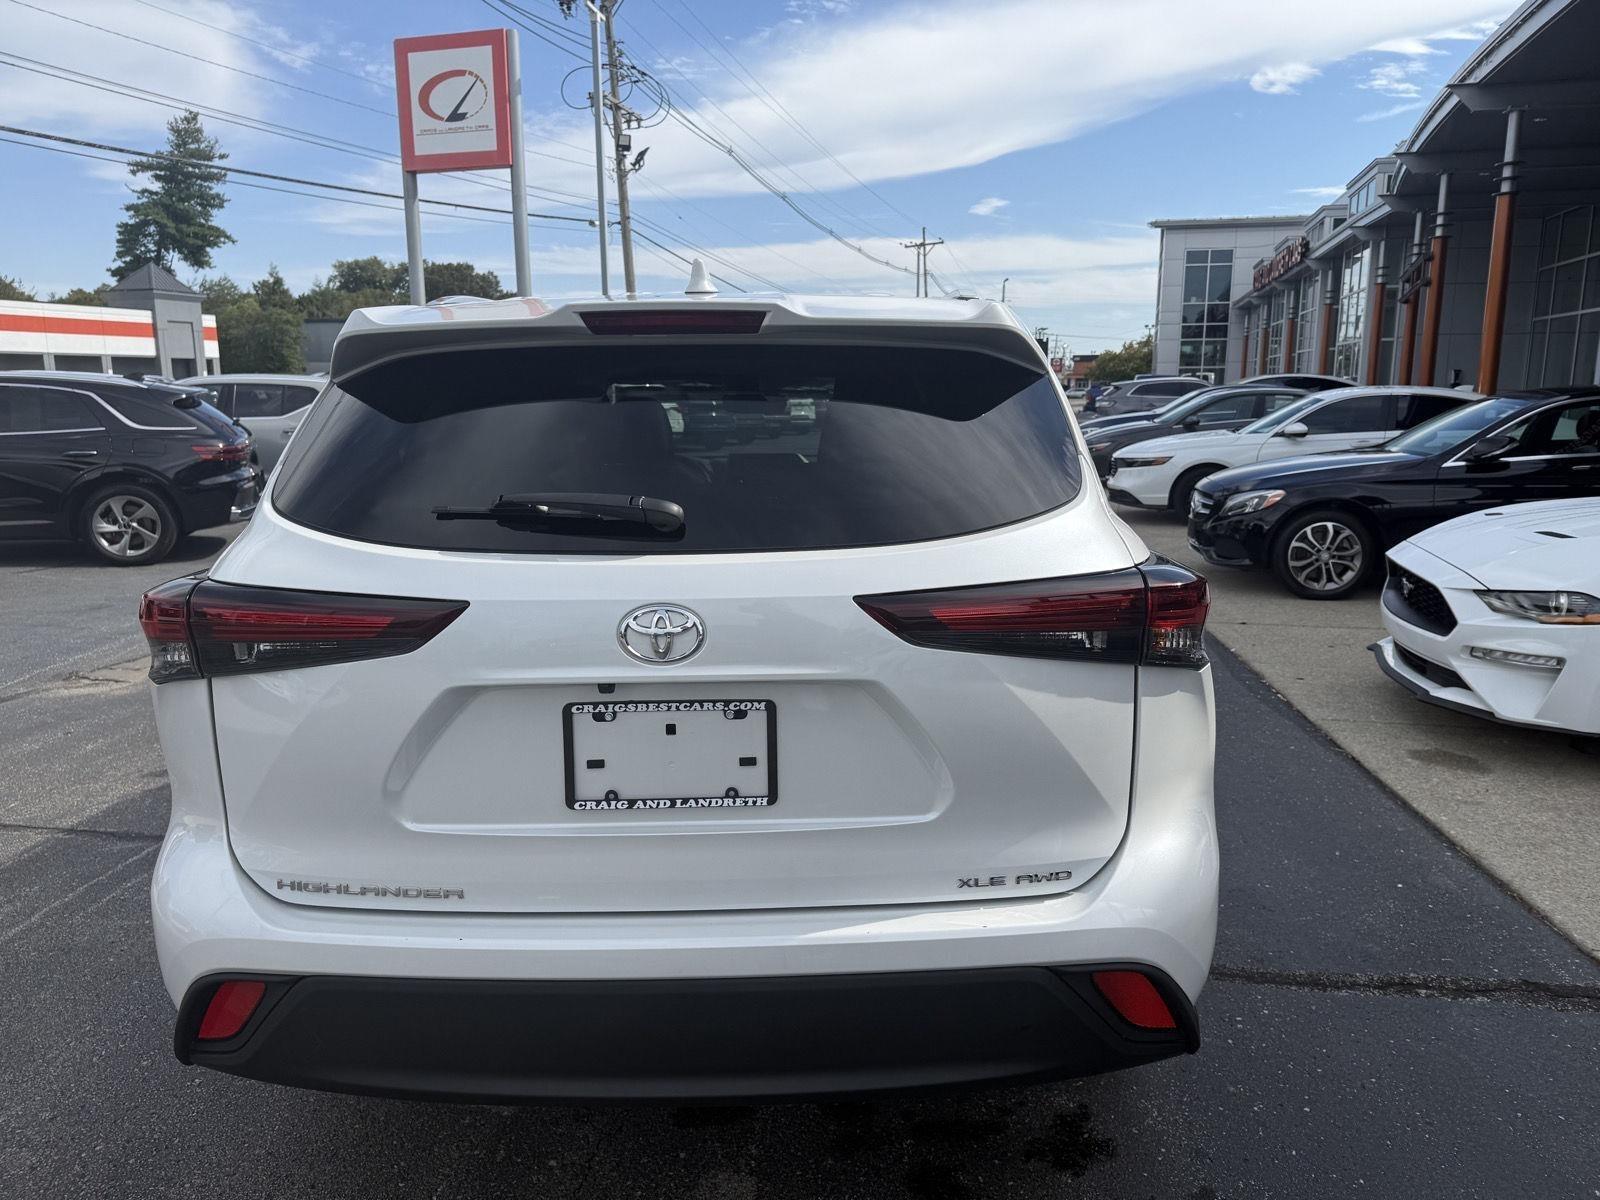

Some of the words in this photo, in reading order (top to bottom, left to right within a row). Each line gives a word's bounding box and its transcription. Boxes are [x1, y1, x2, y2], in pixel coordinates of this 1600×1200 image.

[571, 701, 766, 713] CRAIGSBESTCARS.COM
[573, 800, 629, 810] CRAIG
[632, 799, 671, 809] AND
[675, 797, 769, 808] LANDRETH
[957, 875, 1007, 889] XLE
[1015, 870, 1072, 885] AWD
[277, 878, 465, 900] HIGHLANDER
